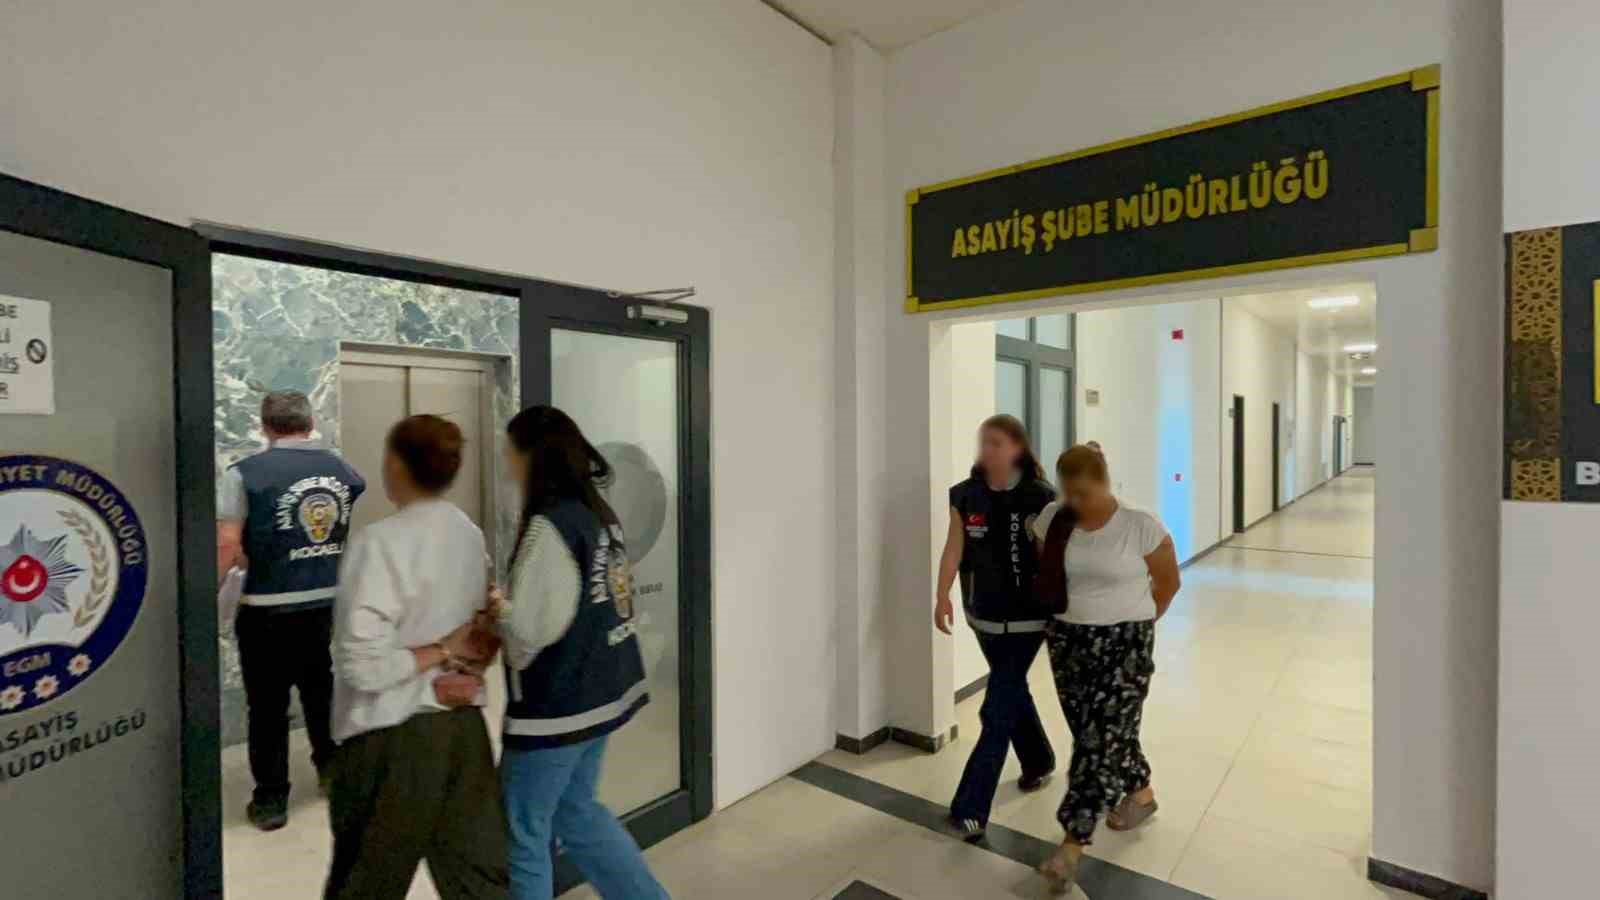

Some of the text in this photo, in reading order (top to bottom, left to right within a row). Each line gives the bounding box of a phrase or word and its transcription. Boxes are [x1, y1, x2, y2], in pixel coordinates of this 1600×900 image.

[951, 150, 1329, 257] ASAYİŞ ŞUBE MÜDÜRLÜĞÜ
[56, 469, 143, 565] MÜDÜRLÜĞÜ
[4, 652, 51, 677] EGM
